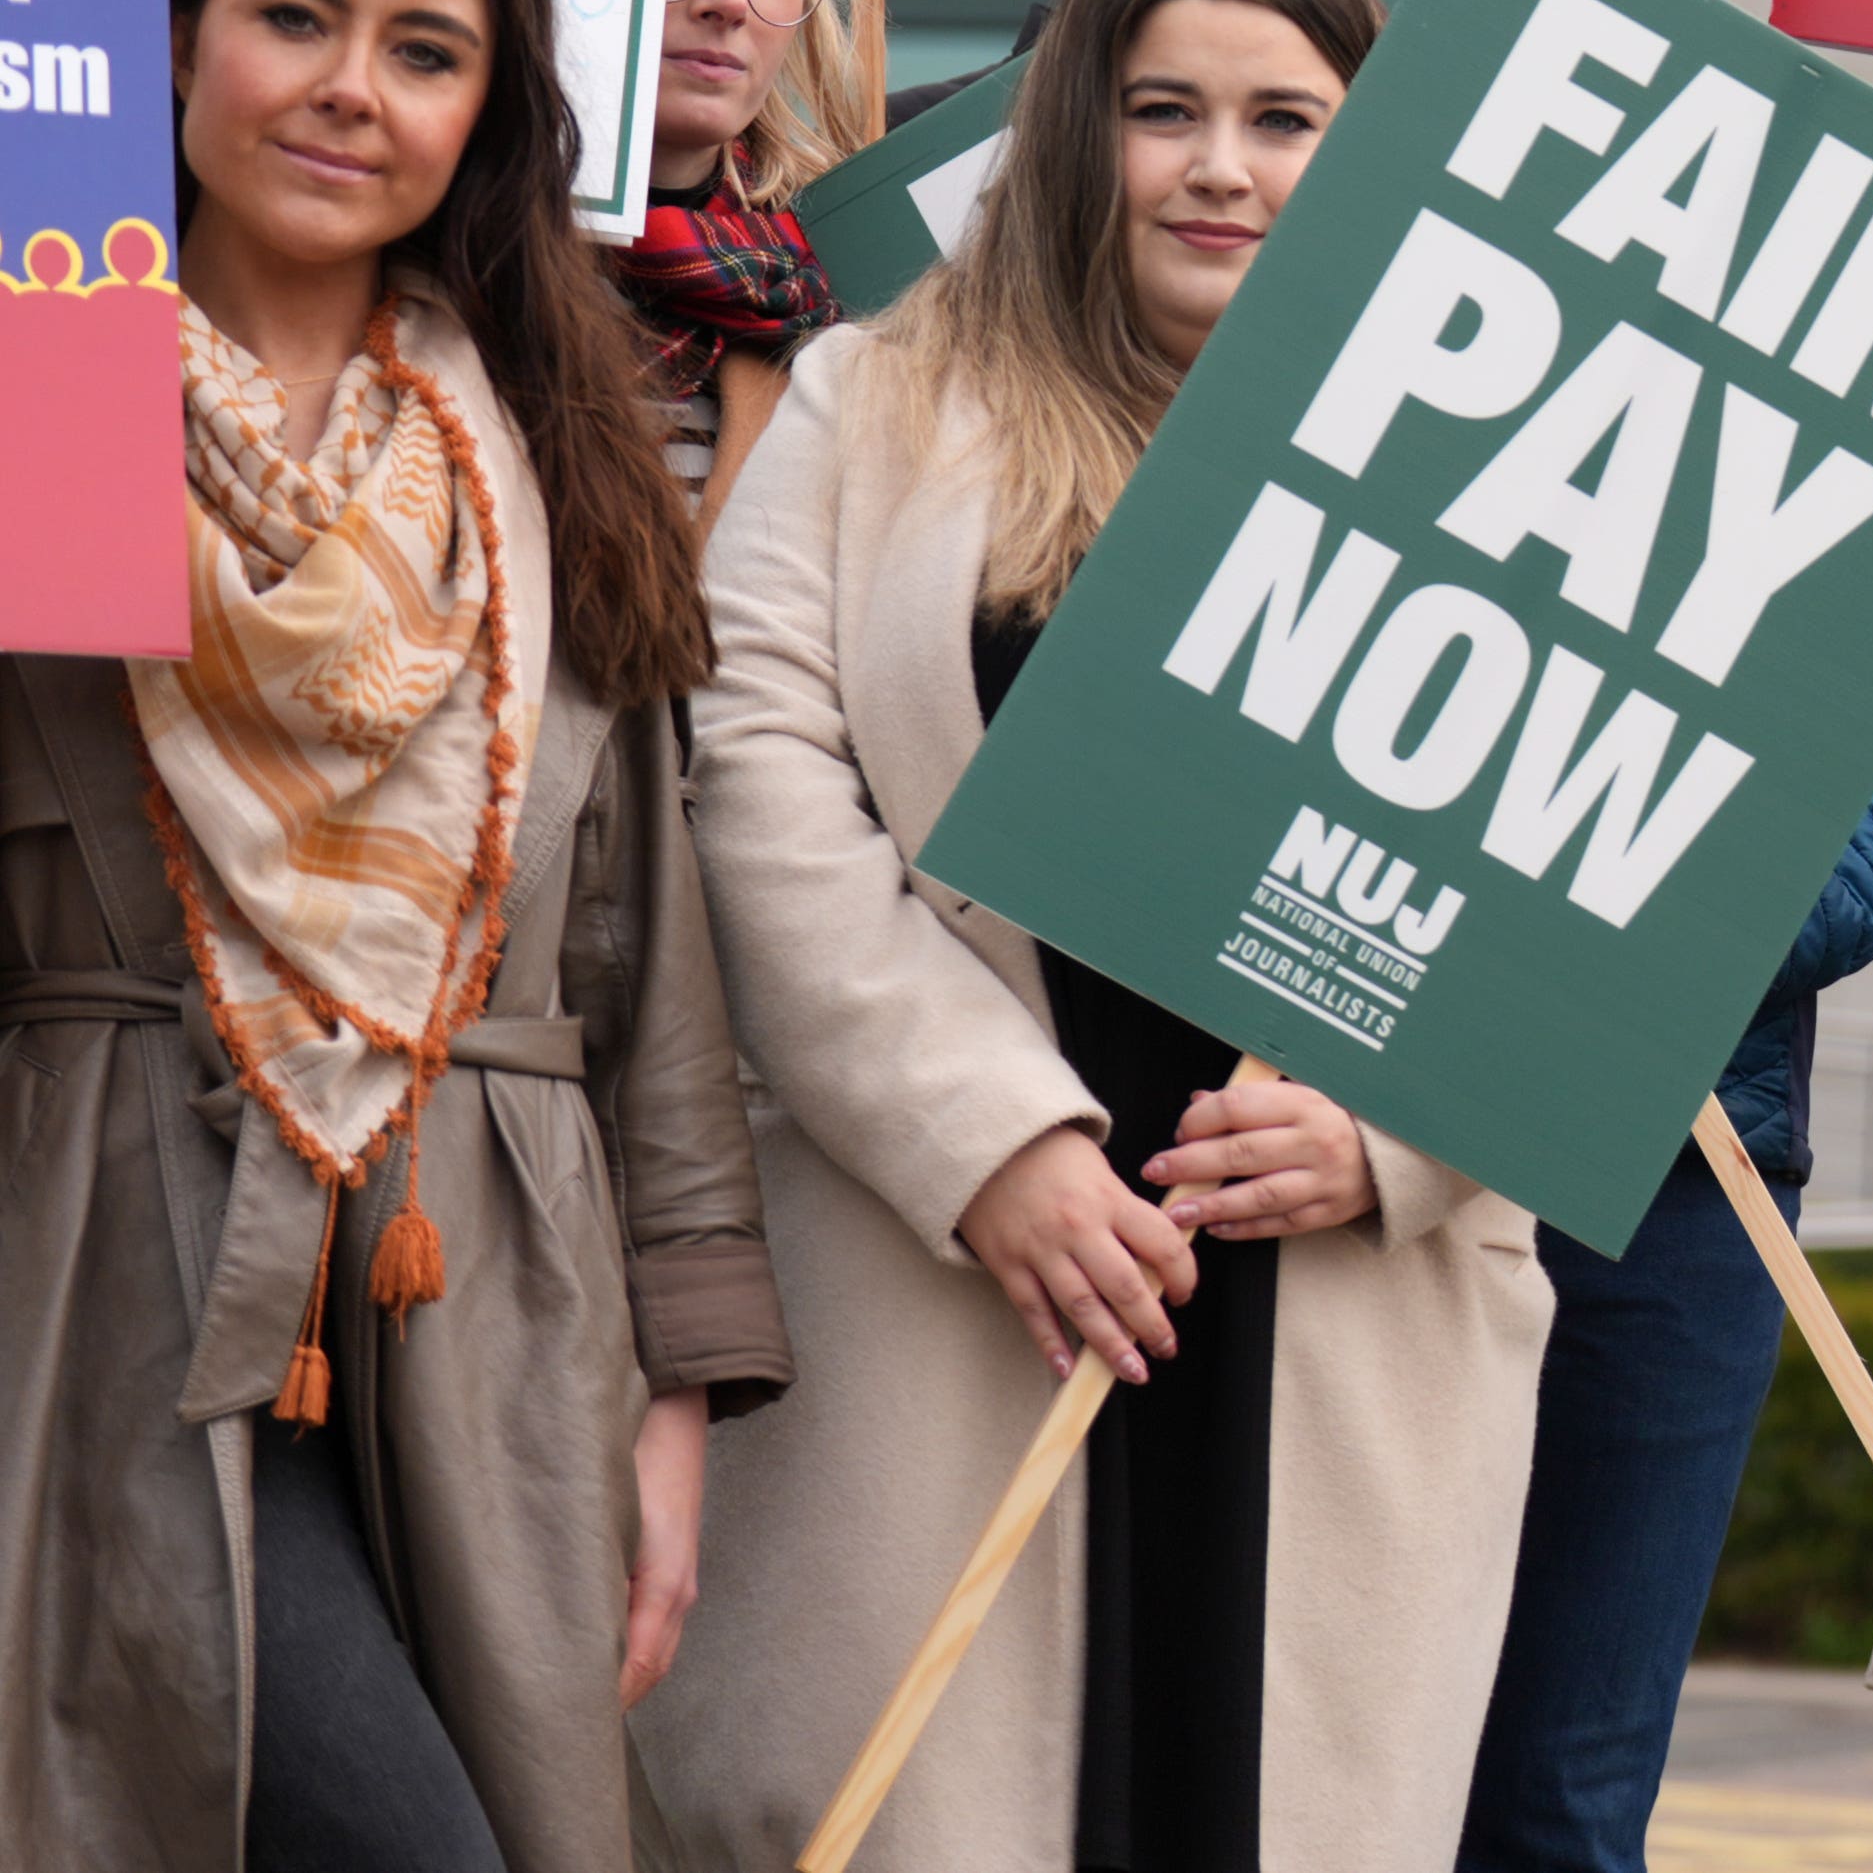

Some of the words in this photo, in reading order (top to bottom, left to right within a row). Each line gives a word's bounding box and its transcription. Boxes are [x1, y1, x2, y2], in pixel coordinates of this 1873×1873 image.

[1161, 480, 1757, 930] NOW
[1267, 803, 1467, 956] NUJ
[1223, 931, 1398, 1039] JOURNALISTS
[1251, 884, 1350, 953] NATIONAL
[1355, 942, 1422, 992] UNION
[1311, 949, 1337, 971] OF
